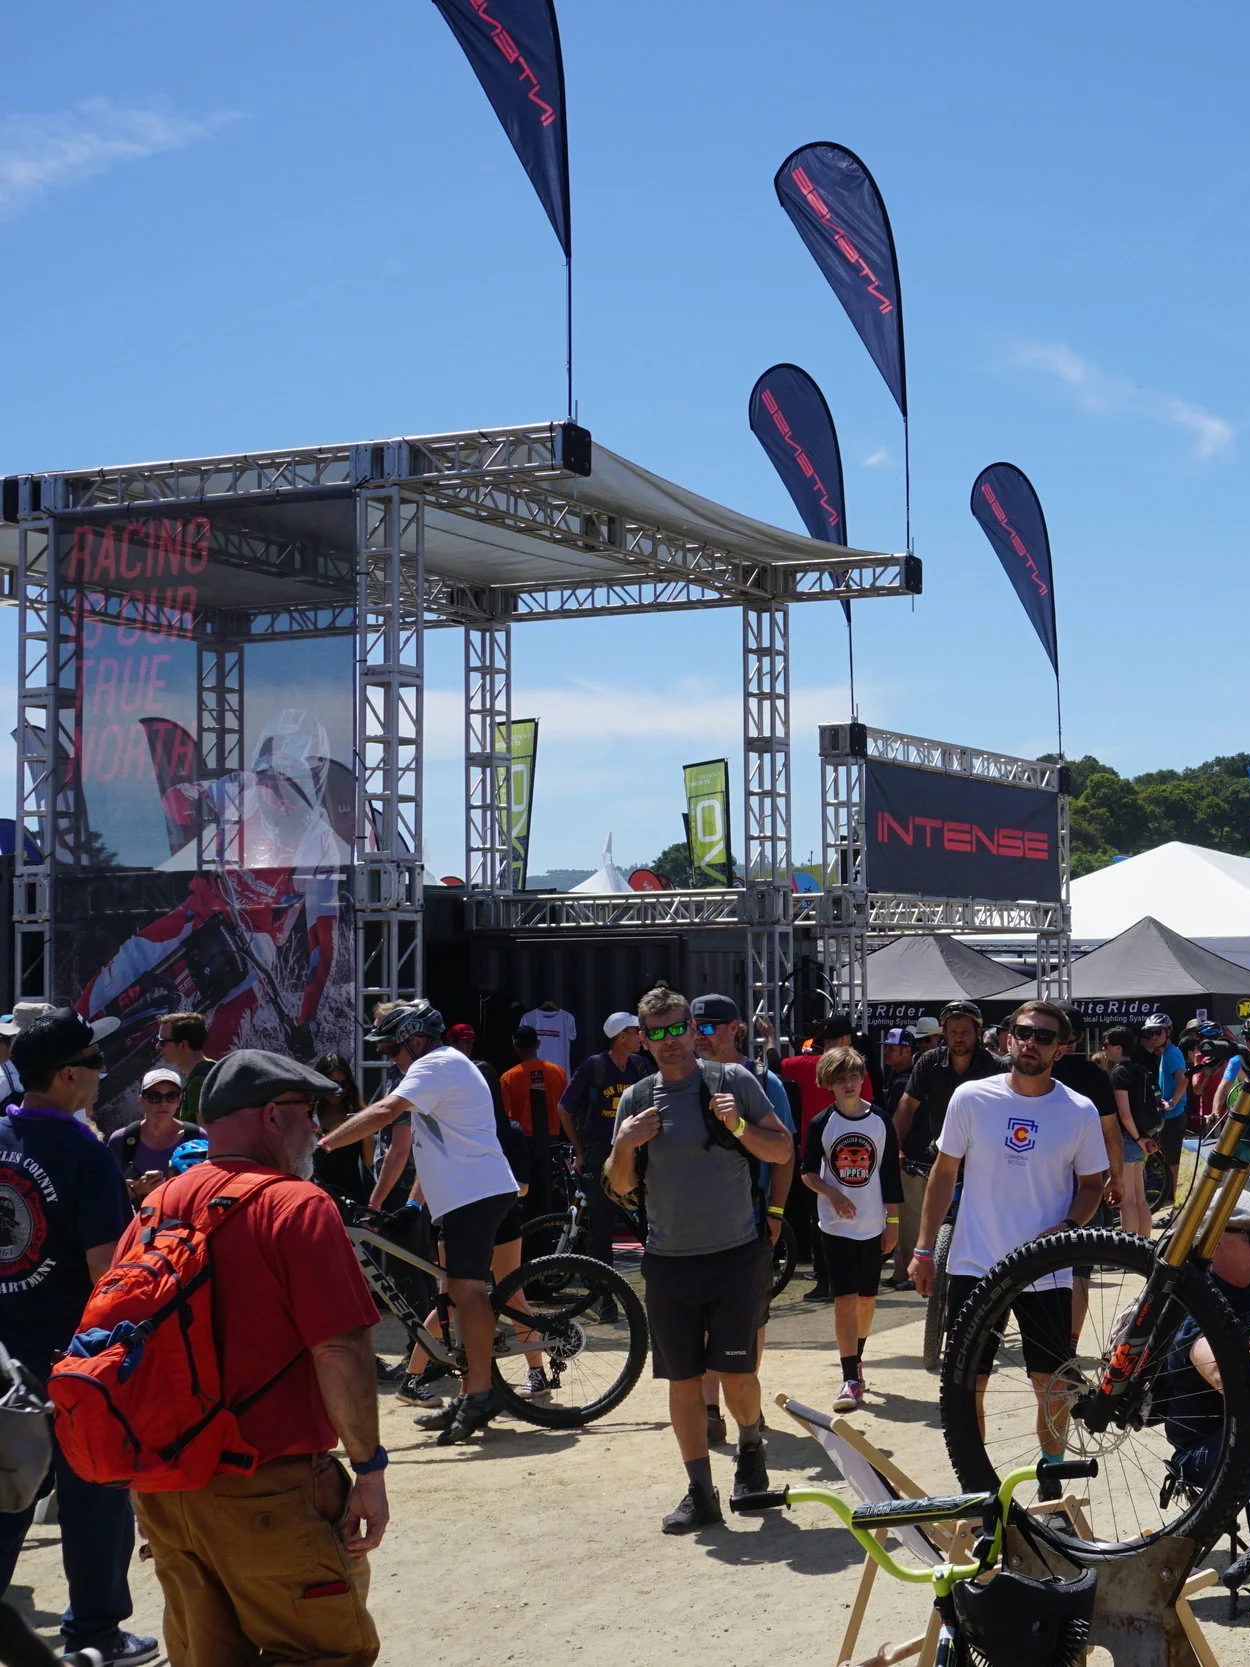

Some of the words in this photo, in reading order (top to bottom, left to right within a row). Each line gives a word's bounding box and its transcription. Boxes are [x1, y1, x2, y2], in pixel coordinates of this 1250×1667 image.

[67, 516, 212, 583] RACING
[116, 584, 198, 647] OUR
[75, 653, 172, 716] TRUE
[65, 720, 197, 782] NORTH
[877, 810, 1049, 860] INTENSE
[23, 1157, 59, 1203] COUNTY
[839, 1166, 870, 1179] RIPPERS
[358, 1256, 424, 1344] TREK
[953, 1276, 1012, 1385] SCHWALBE
